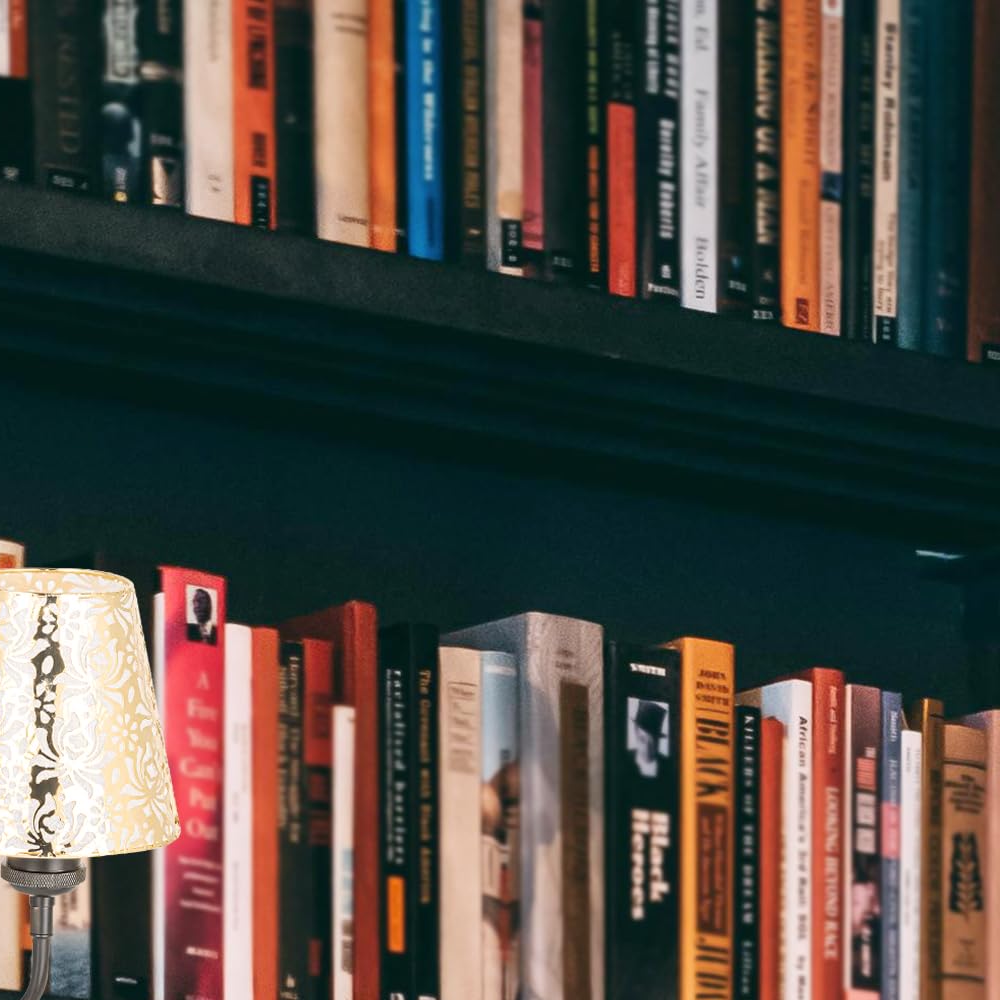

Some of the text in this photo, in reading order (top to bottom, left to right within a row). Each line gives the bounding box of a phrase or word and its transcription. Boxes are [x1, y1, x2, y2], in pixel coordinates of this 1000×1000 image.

[423, 92, 436, 181] Wilderness
[691, 89, 709, 148] Family
[881, 22, 897, 182] Stanley Robinson
[693, 154, 709, 209] Affair
[693, 237, 709, 300] Bolden
[695, 716, 729, 799] BLACK
[741, 716, 754, 788] KILLERS
[796, 715, 809, 768] African
[393, 781, 407, 865] barriers
[419, 670, 432, 903] The Covenant with Black America
[631, 808, 652, 921] Heroes
[650, 812, 671, 902] Black
[741, 824, 754, 856] THE
[823, 785, 839, 961] LOOKING BEYOND RACE
[741, 864, 754, 925] DREAM
